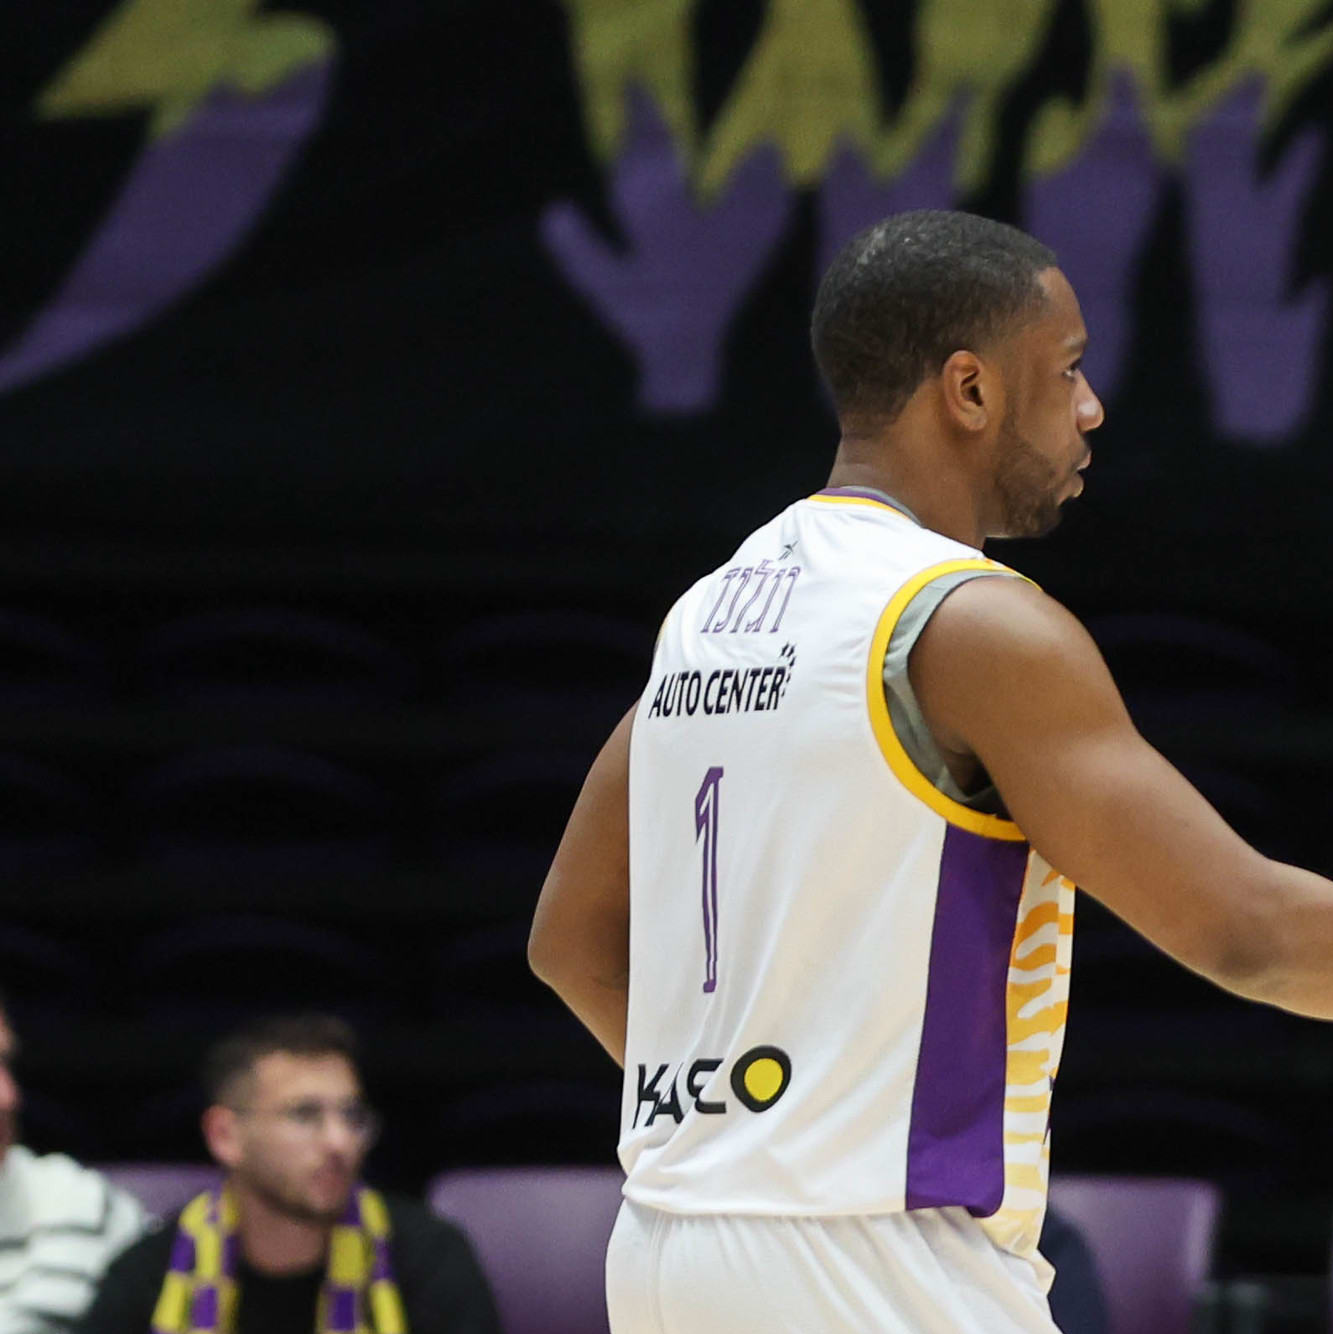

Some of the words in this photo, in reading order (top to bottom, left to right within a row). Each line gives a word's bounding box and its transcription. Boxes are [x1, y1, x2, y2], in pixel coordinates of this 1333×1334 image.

[648, 669, 702, 719] AUTO
[703, 665, 787, 715] CENTER
[694, 765, 724, 994] 1
